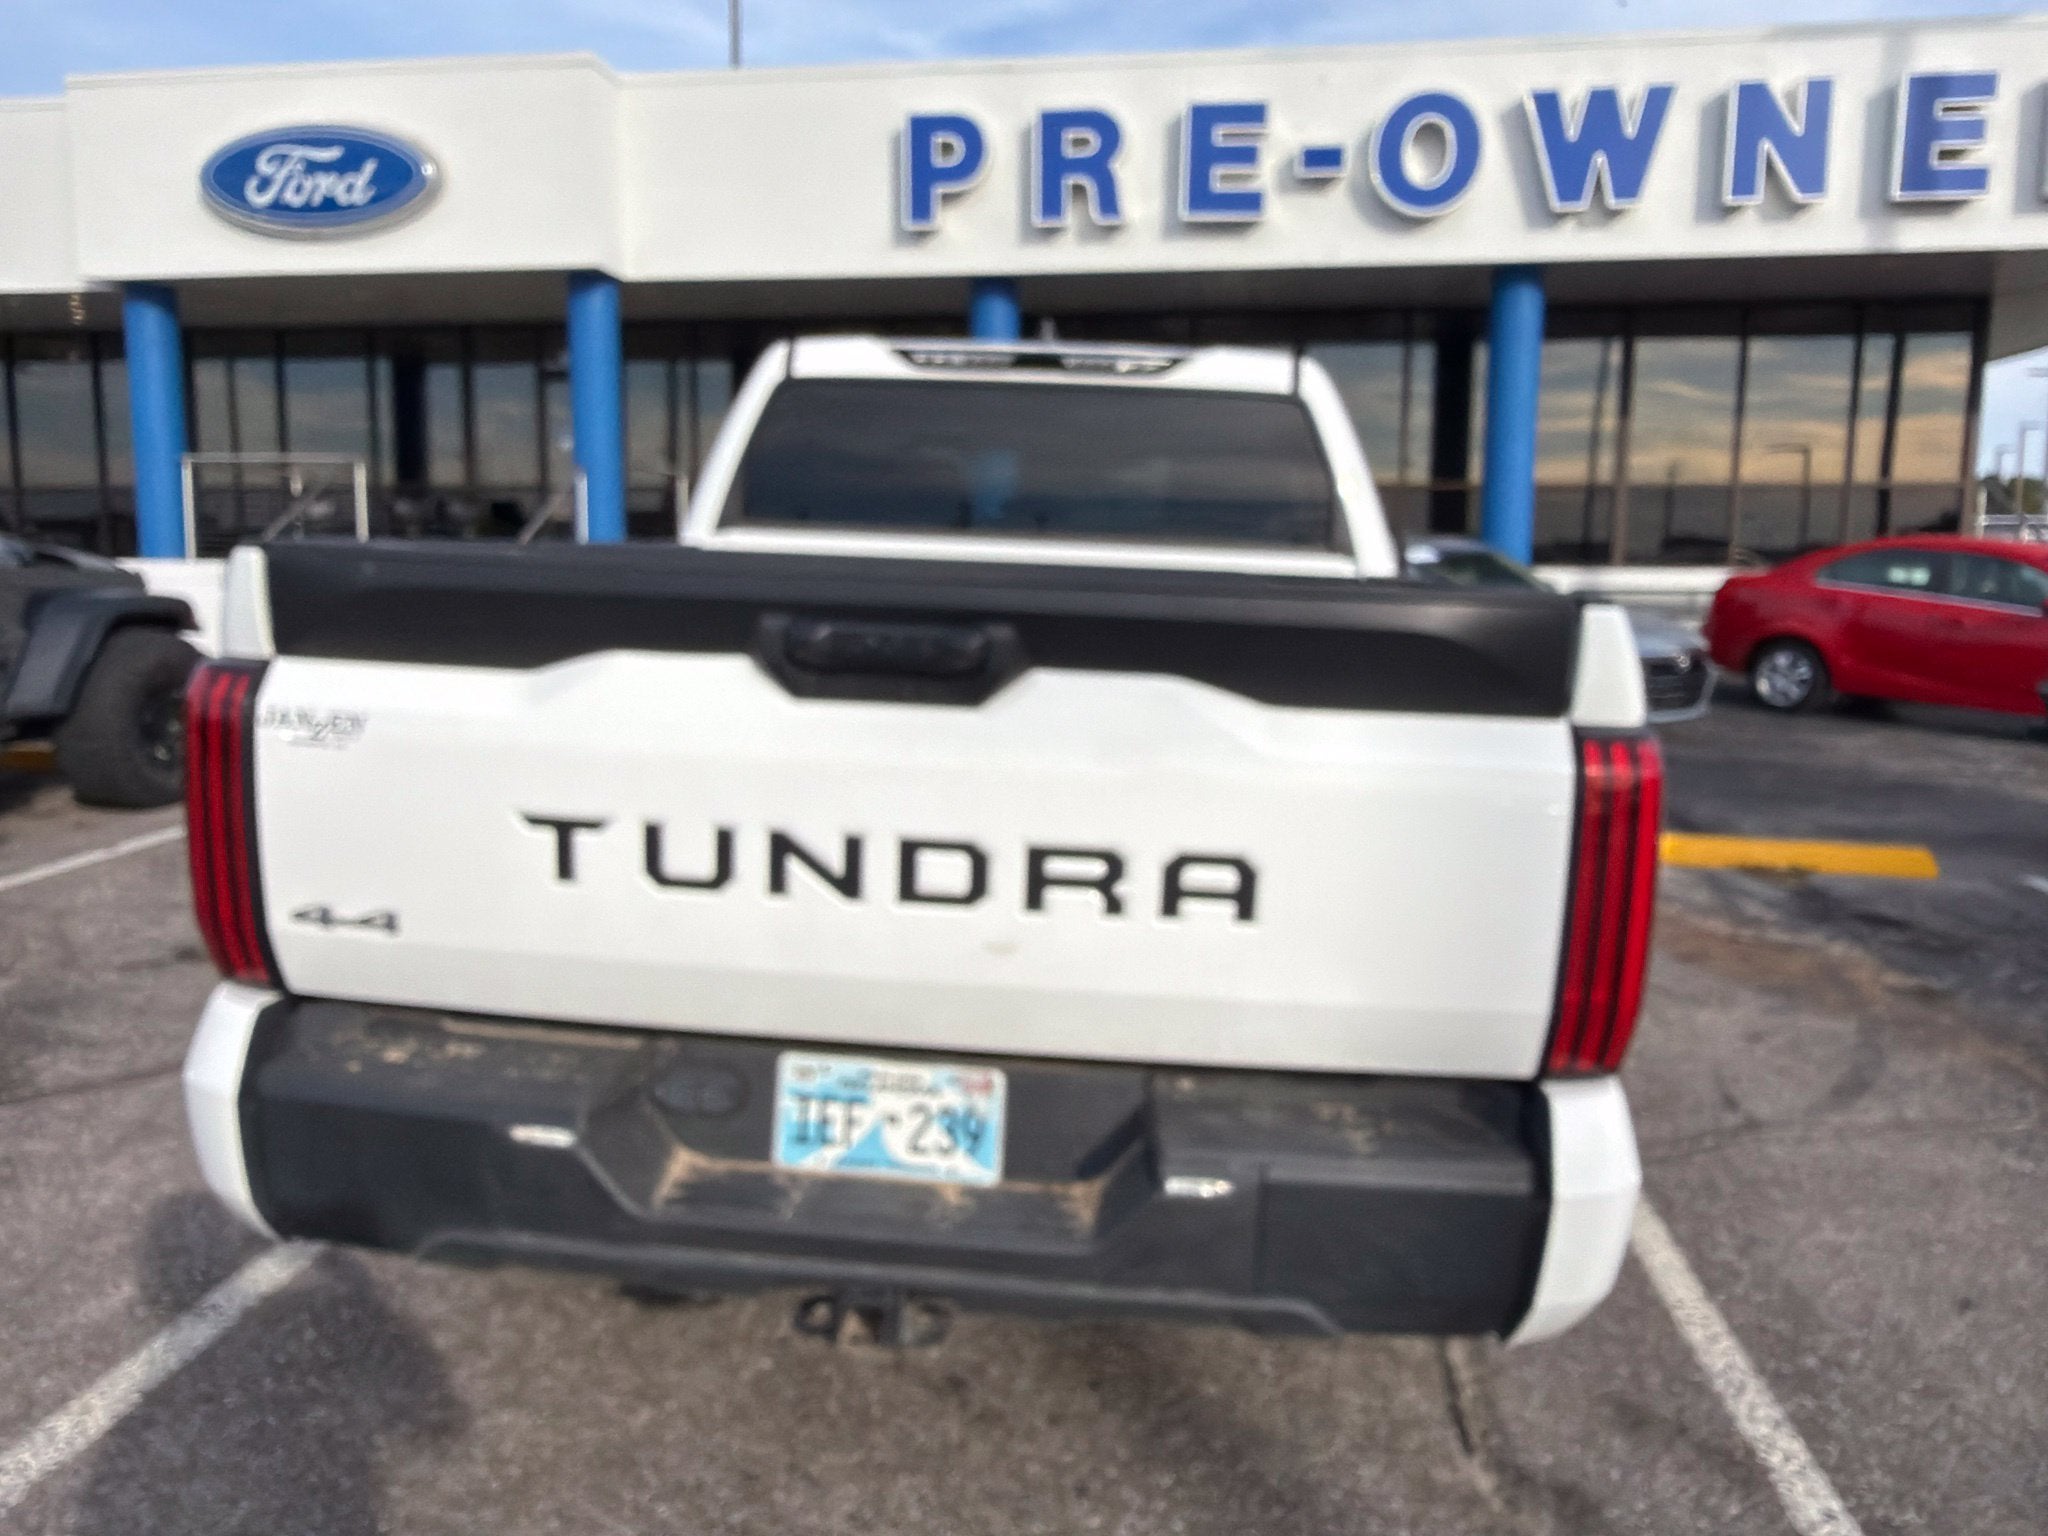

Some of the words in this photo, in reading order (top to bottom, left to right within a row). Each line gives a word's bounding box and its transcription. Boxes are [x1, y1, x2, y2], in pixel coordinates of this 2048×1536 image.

[243, 143, 380, 209] Ford
[902, 69, 2048, 233] PRE-OWNE
[520, 812, 1258, 922] TUNDRA
